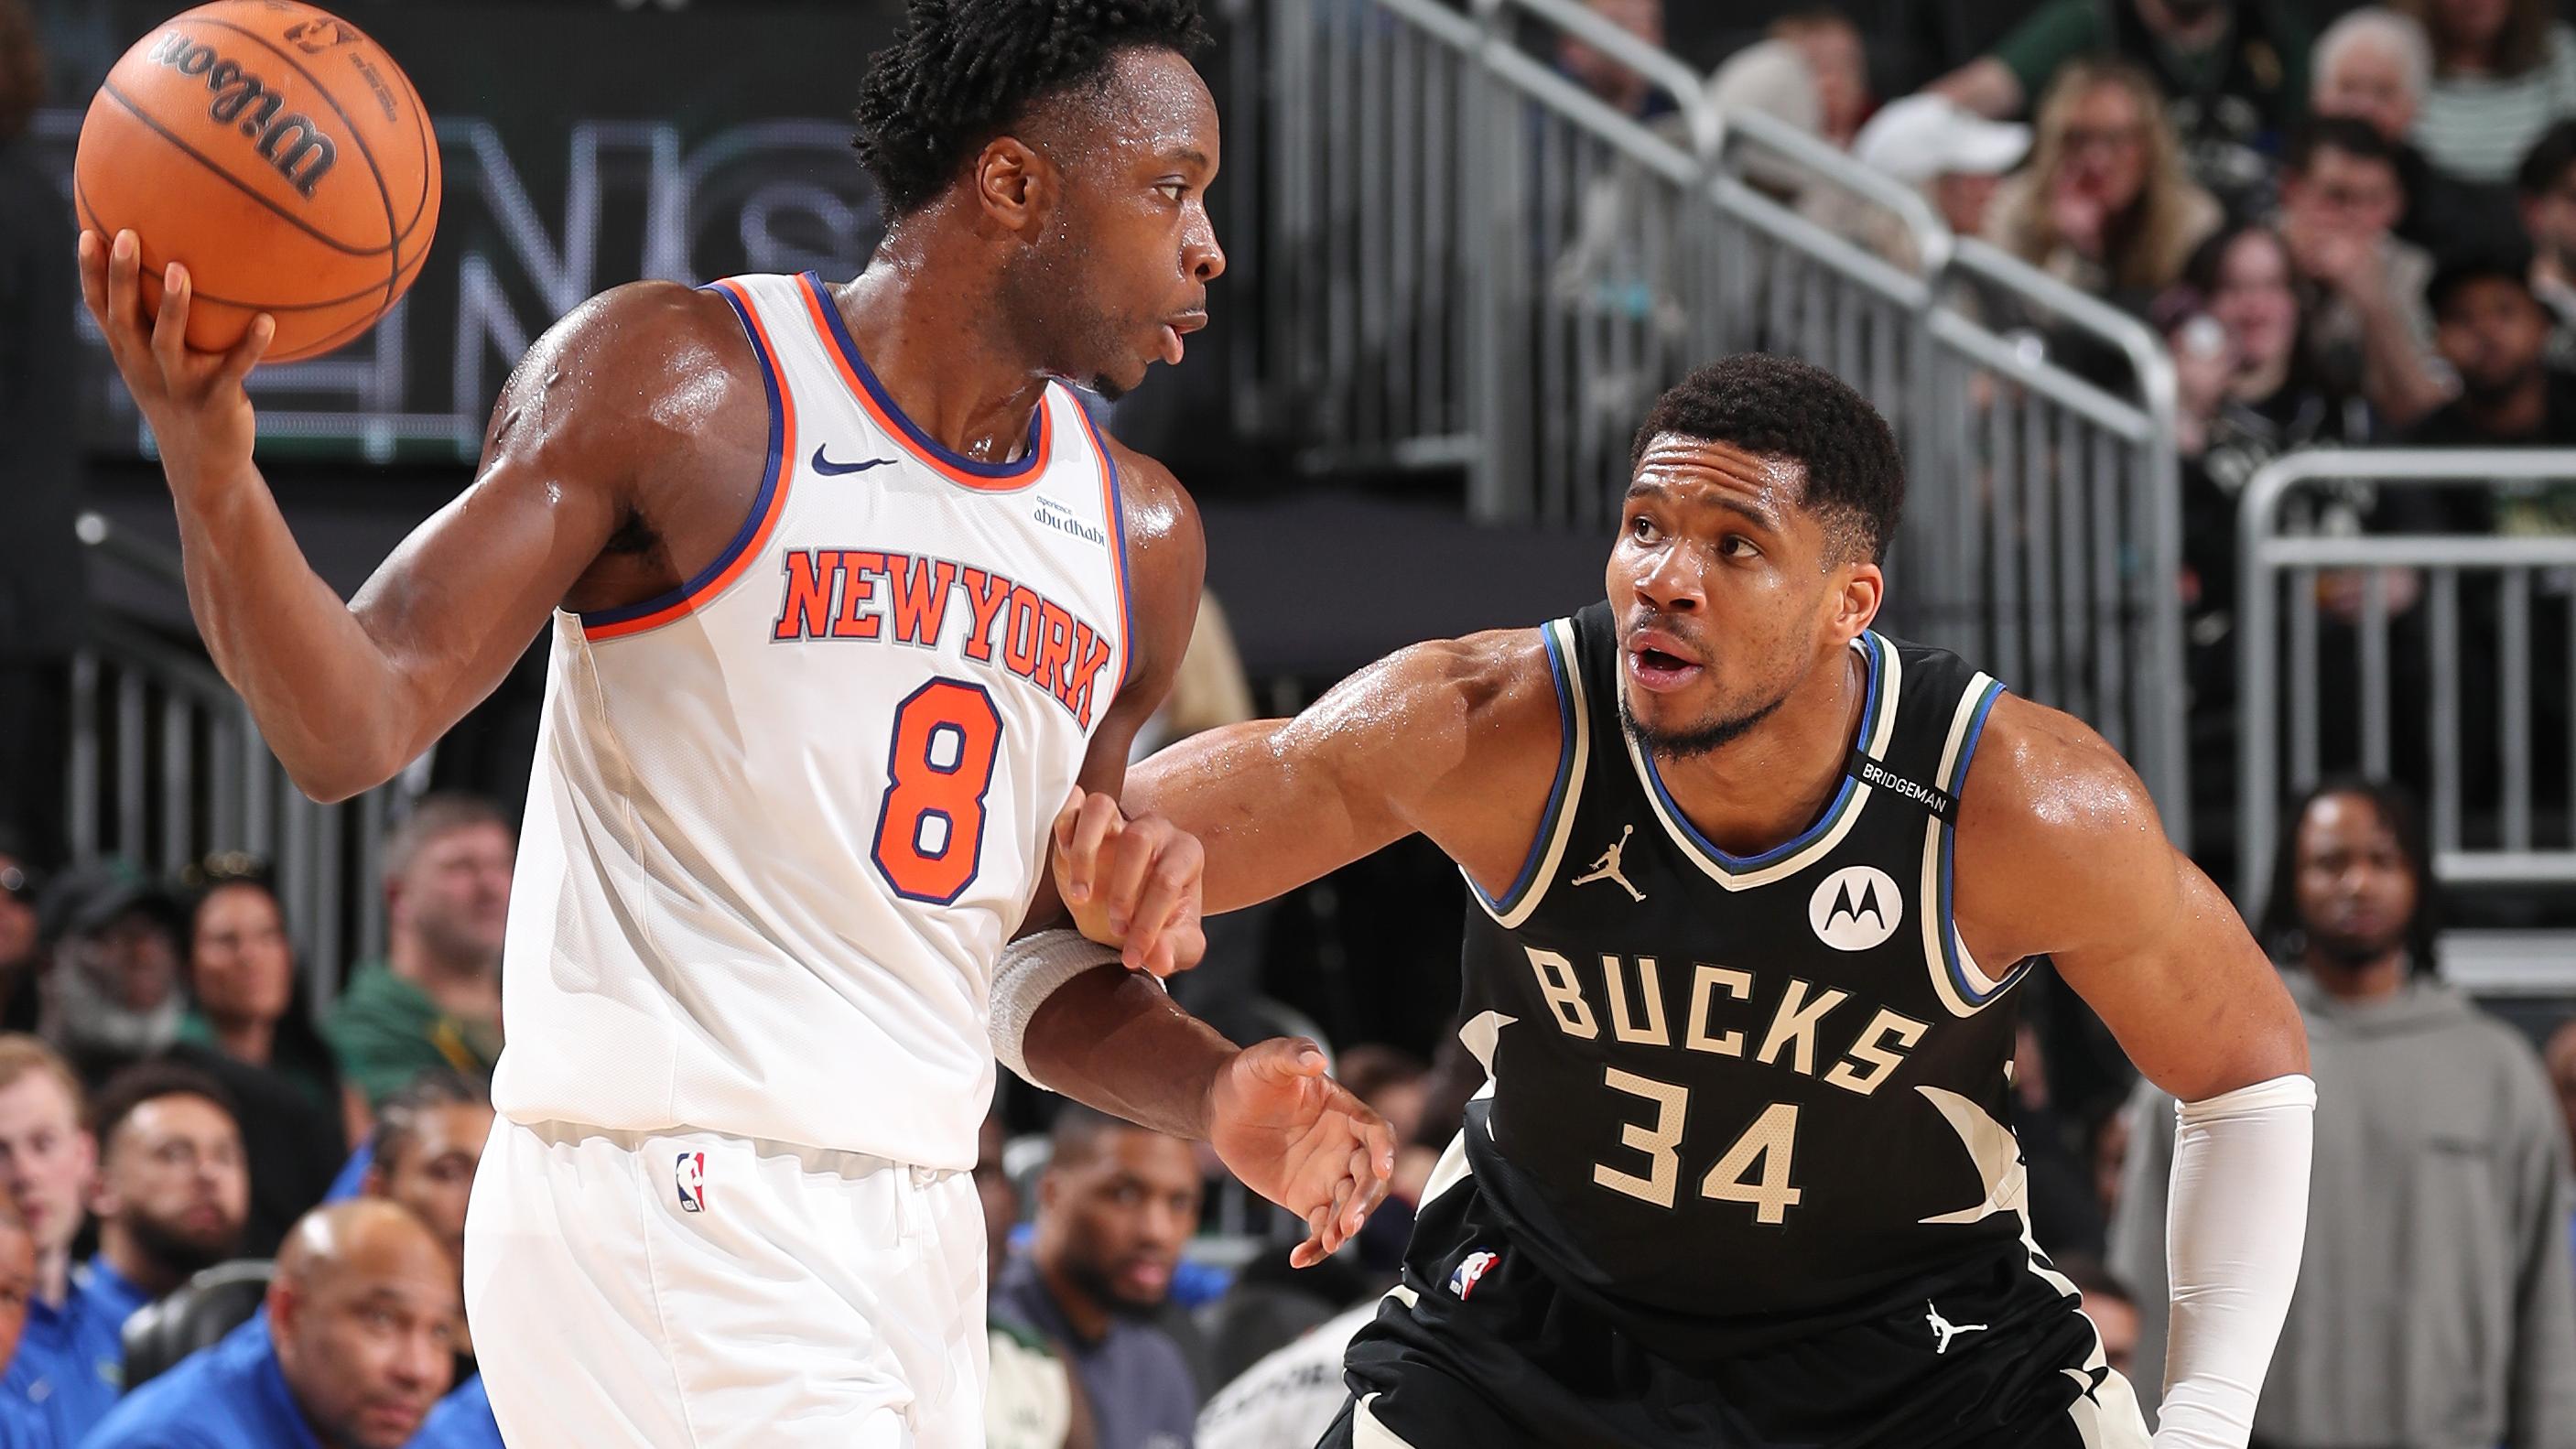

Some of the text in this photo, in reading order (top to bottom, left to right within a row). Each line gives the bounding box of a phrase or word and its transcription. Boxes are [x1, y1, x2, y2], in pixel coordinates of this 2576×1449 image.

[147, 29, 337, 201] Wilson
[1034, 508, 1105, 547] abu dhabi
[769, 546, 1112, 738] NEW YORK
[871, 676, 1004, 907] 8
[1862, 762, 1947, 813] BRIDGEMAN
[1523, 946, 1930, 1097] BUCKS
[1593, 1065, 1802, 1225] 34
